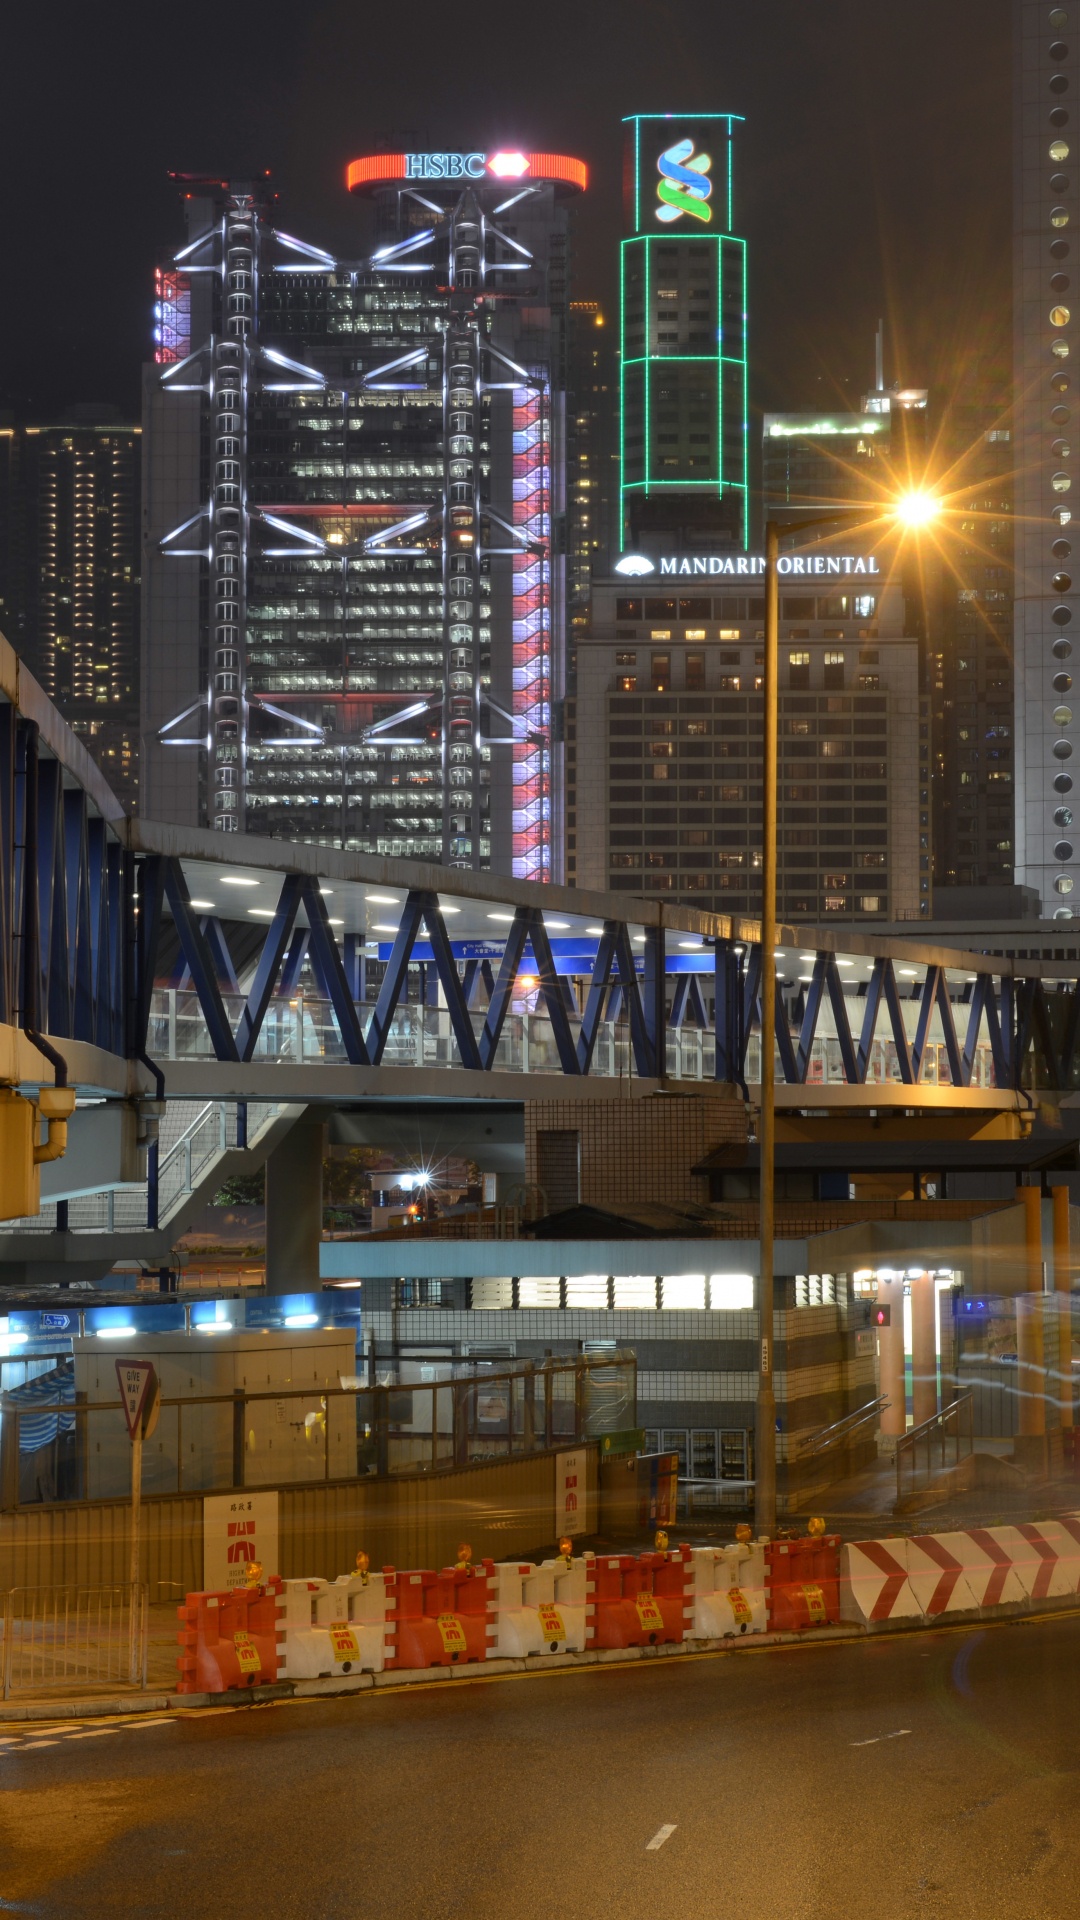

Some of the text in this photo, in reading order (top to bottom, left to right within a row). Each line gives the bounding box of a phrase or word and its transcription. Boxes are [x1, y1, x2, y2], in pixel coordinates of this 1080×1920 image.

[405, 153, 486, 179] HSBC
[660, 556, 880, 574] MANDARIN ORIENTAL
[126, 1370, 140, 1382] GIVE
[127, 1383, 140, 1394] WAY
